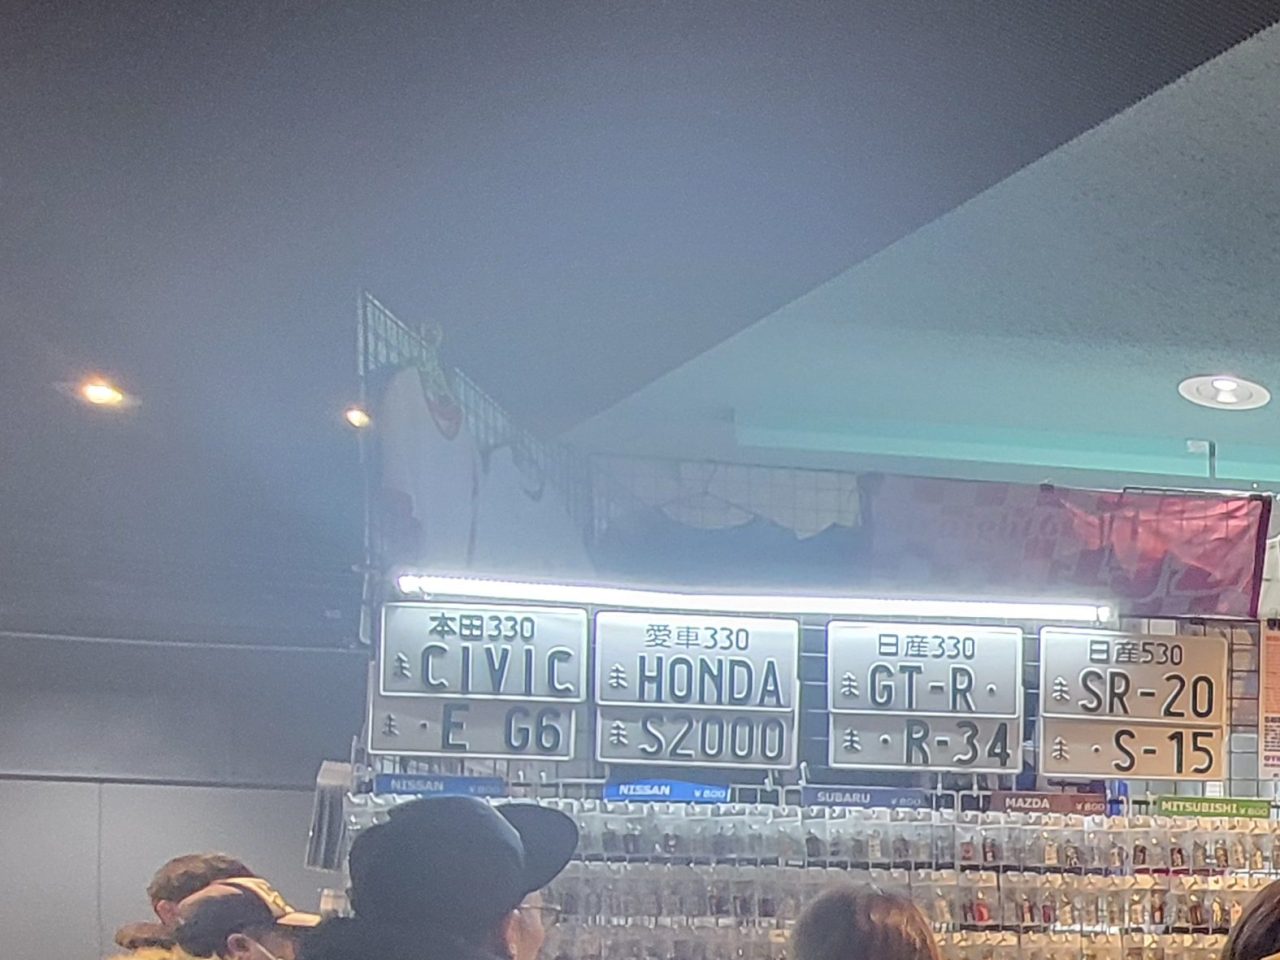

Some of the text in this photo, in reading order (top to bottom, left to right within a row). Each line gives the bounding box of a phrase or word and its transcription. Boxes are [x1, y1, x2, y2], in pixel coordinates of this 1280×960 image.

[429, 612, 535, 642] 本田330
[644, 624, 750, 651] 愛車330
[878, 633, 975, 660] 日産330
[1089, 639, 1183, 666] 日産530
[421, 641, 575, 696] CIVIC
[637, 653, 783, 706] HONDA
[1078, 667, 1214, 719] SR-20
[441, 703, 470, 751] E
[505, 704, 562, 752] G6
[638, 712, 785, 760] S2000
[390, 778, 444, 792] NISSAN
[619, 784, 671, 796] NISSAN
[817, 790, 871, 804] SUBARU
[1005, 797, 1050, 809] MAZDA
[1161, 799, 1237, 814] MITSUBISHI
